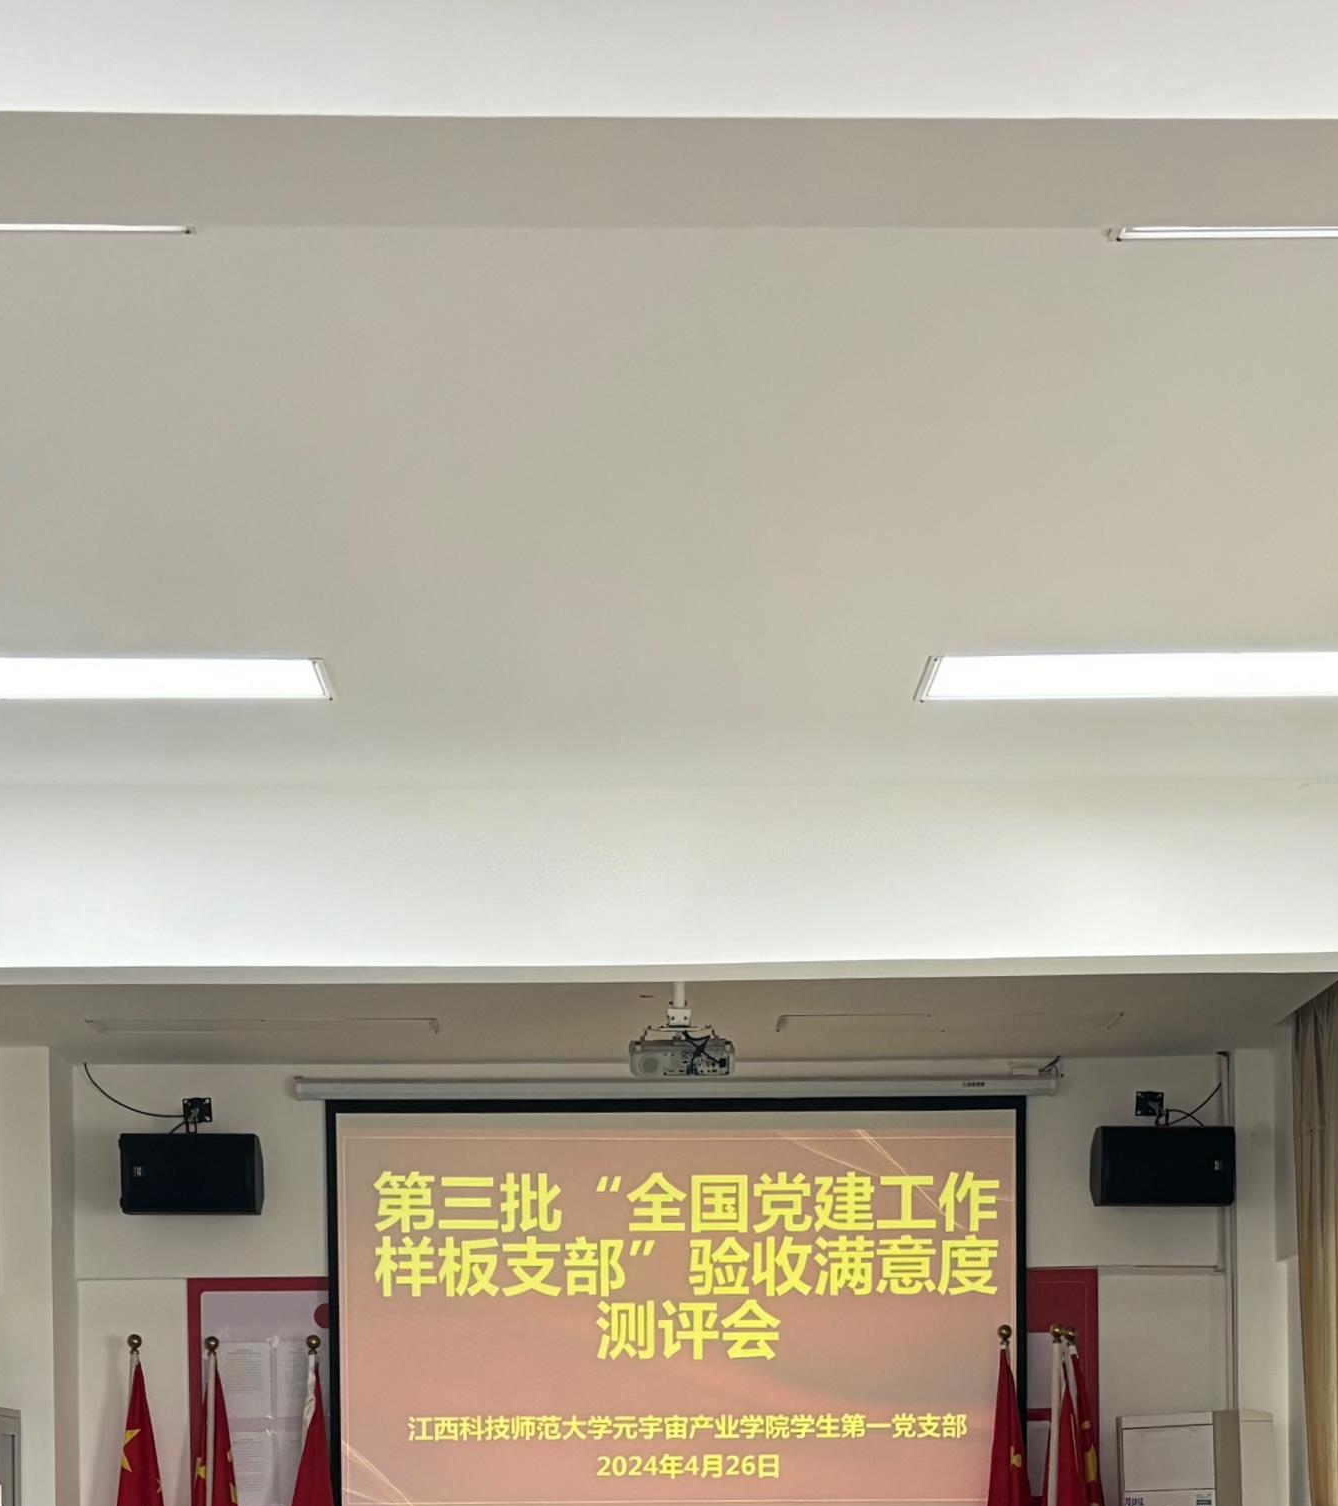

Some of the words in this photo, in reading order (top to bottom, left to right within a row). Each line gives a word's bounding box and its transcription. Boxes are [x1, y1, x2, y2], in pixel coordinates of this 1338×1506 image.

[373, 1171, 1000, 1234] 第三批“全国党建工作
[374, 1236, 998, 1297] 样板支部”验收满意度
[596, 1300, 781, 1360] 测评会
[408, 1414, 967, 1441] 江西科技师范大学元宇宙产业学院学生第一党支部
[597, 1454, 780, 1479] 2024年4月26日
